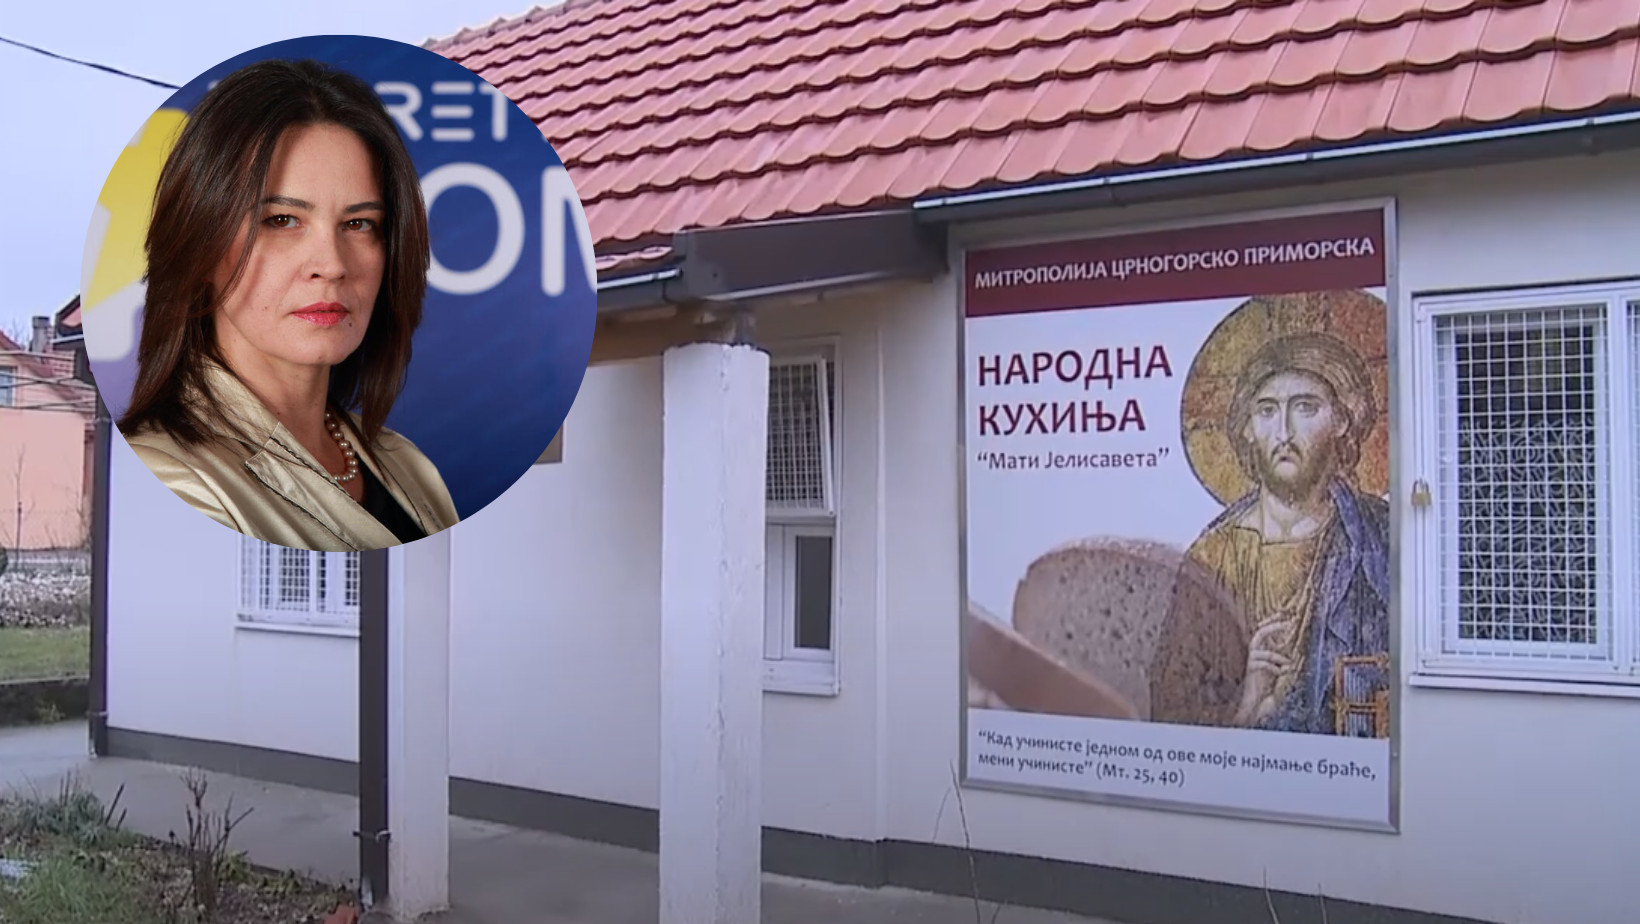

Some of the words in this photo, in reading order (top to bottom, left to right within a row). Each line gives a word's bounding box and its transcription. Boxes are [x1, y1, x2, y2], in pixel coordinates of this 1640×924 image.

[974, 261, 1107, 290] МИТРОПОЛИЈА
[1111, 247, 1239, 281] ЦРНОГОРСКО
[1243, 236, 1375, 266] ПРИМОРСКА
[978, 345, 1173, 389] НАРОДНА
[978, 399, 1147, 437] КУХИЊА
[978, 752, 1015, 768] мени
[1158, 768, 1186, 788] 40)
[1016, 736, 1083, 753] учинисте
[1085, 738, 1139, 758] једном
[1143, 747, 1163, 763] од
[1167, 750, 1196, 763] ове
[1200, 750, 1238, 770] моје
[1241, 754, 1313, 774] најмање
